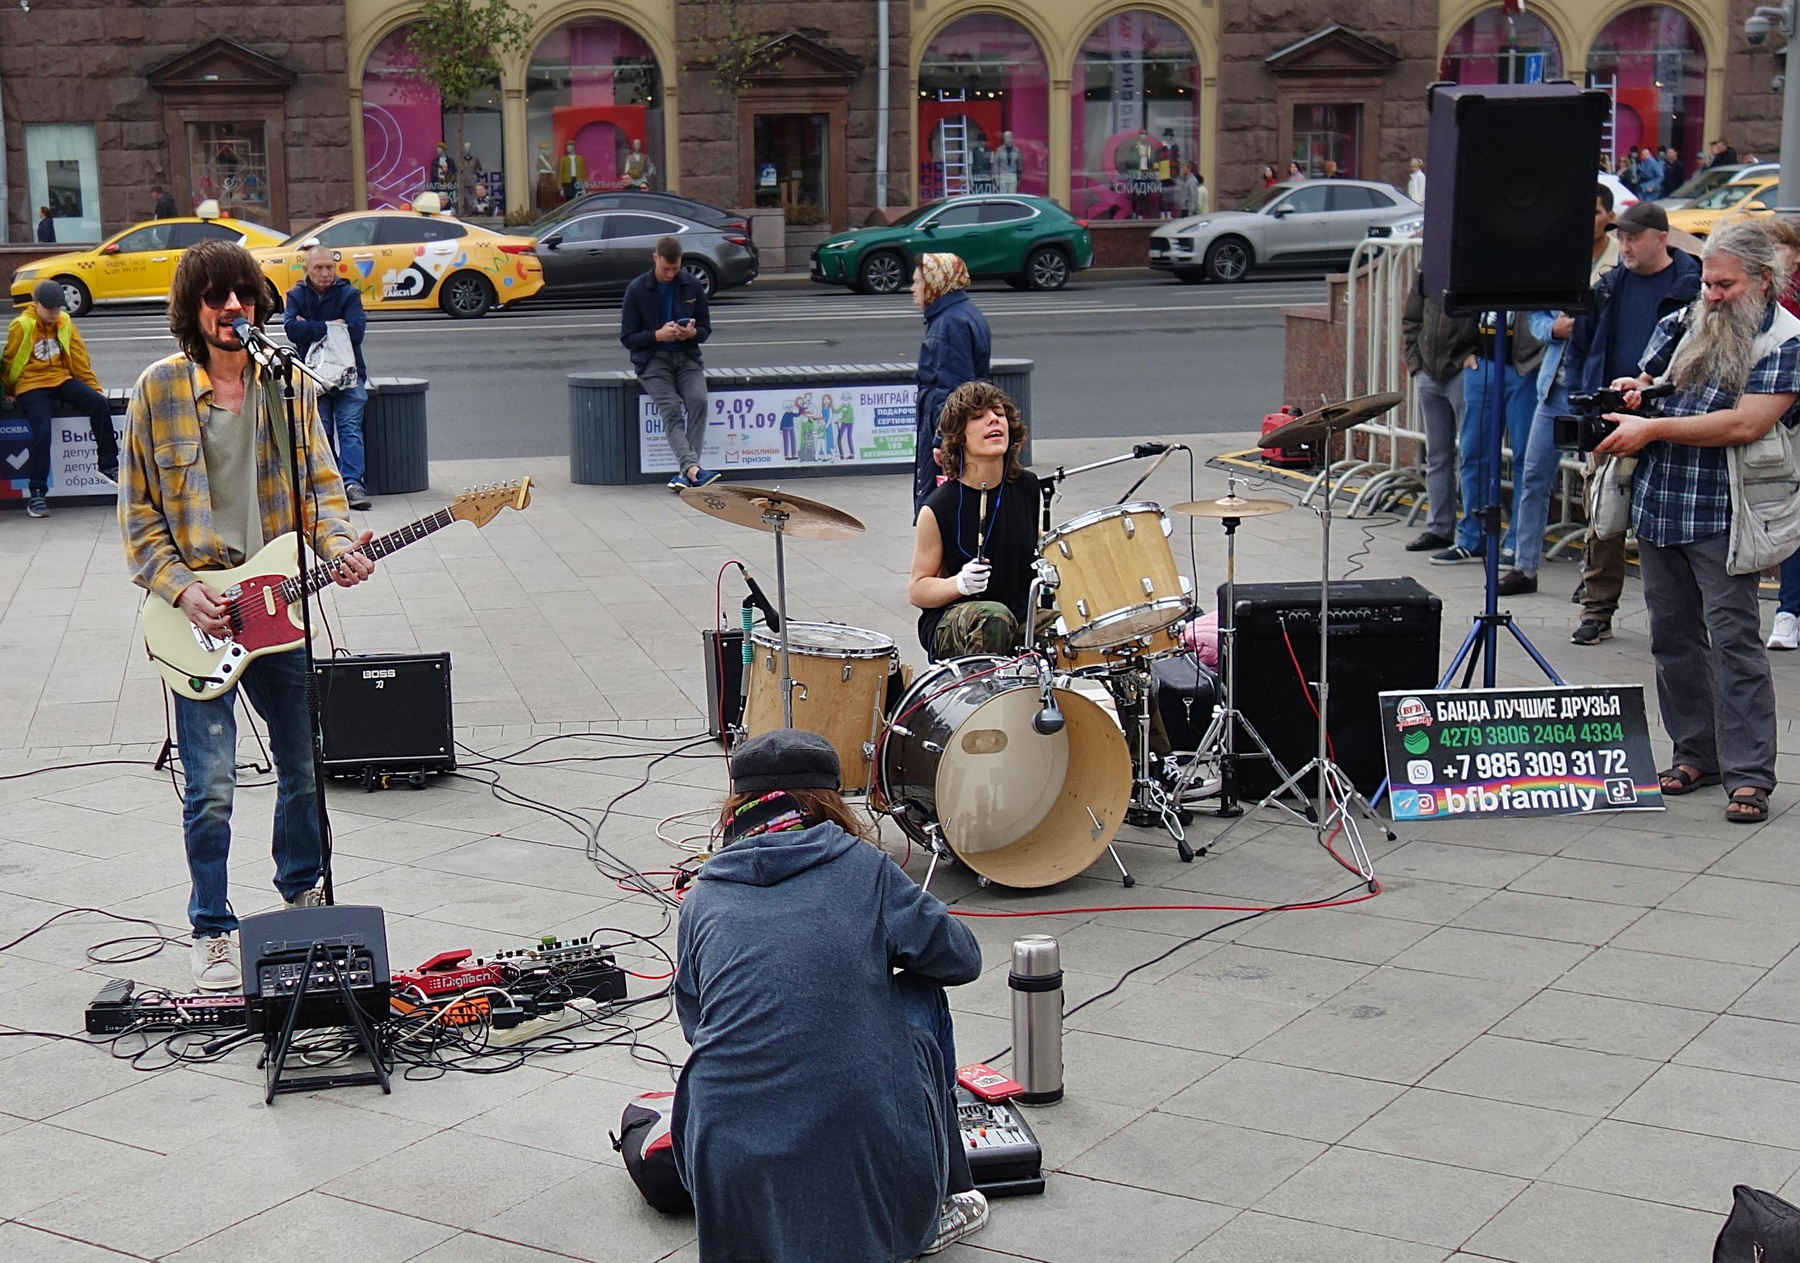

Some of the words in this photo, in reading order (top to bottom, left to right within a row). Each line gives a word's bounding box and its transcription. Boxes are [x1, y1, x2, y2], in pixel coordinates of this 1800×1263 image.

[411, 182, 458, 190] ФИНАЛЬНЫ
[960, 184, 1002, 196] СКИДК
[1116, 182, 1163, 196] СКИДКИ
[382, 268, 424, 296] 10
[384, 289, 410, 297] ТАКСИ
[860, 389, 909, 406] ВЫИГРАЙ
[715, 398, 754, 414] 9.09
[877, 407, 917, 416] ПОДАРОЧН
[877, 417, 916, 425] СЕРТИФИК
[0, 425, 29, 434] ОСКВА
[863, 448, 913, 458] АВТОМОБИЛЕЙ
[64, 462, 98, 473] депут
[65, 475, 108, 487] образо
[362, 669, 396, 679] BOSS
[1402, 704, 1421, 716] BFB
[1436, 700, 1491, 723] БАНДА
[1493, 698, 1557, 720] ЛУЧШИЕ
[1560, 695, 1621, 720] ДРУЗЬЯ
[1439, 726, 1483, 748] 4279
[1486, 725, 1530, 745] 3806
[1533, 723, 1577, 744] 2464
[1580, 721, 1625, 742] 4334
[1443, 754, 1471, 780] +7
[1476, 752, 1521, 779] 985
[1525, 750, 1567, 777] 309
[1571, 750, 1596, 776] 31
[1598, 749, 1629, 775] 72
[1445, 783, 1598, 814] bfbfamily
[442, 973, 492, 988] DigiTech
